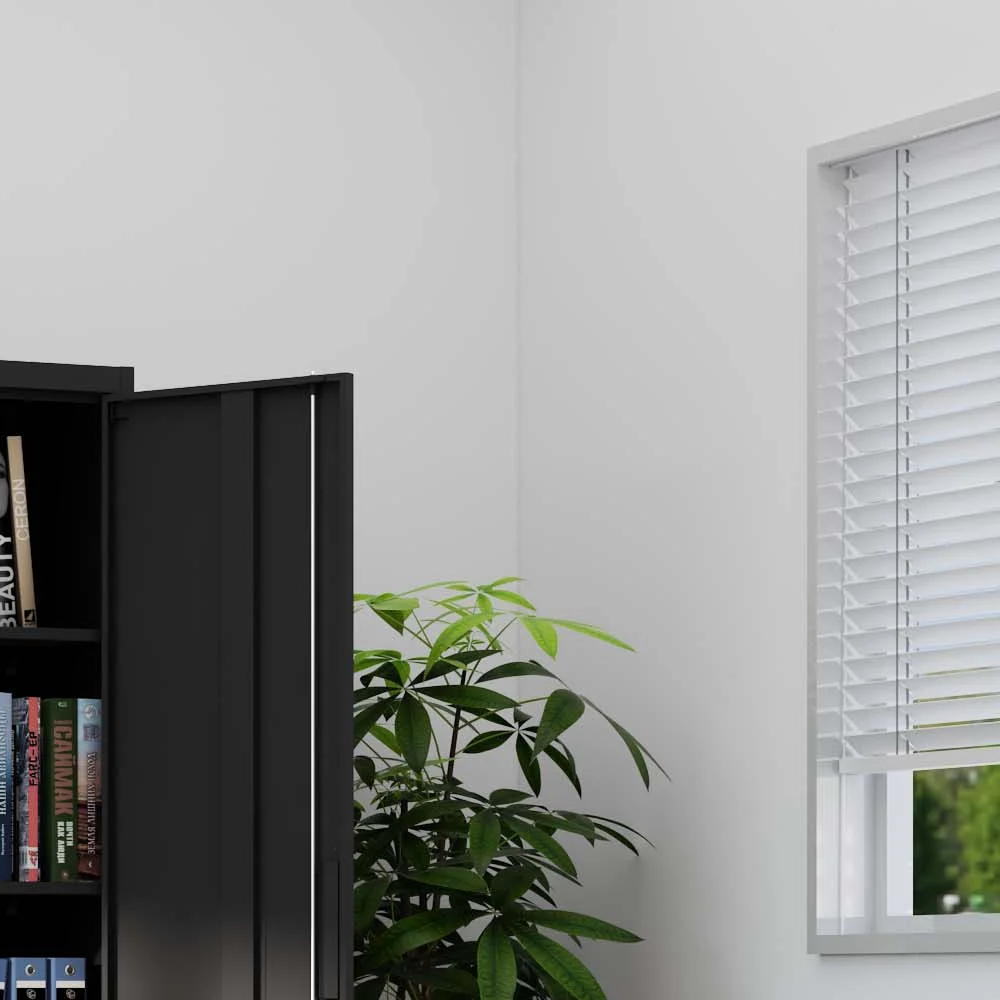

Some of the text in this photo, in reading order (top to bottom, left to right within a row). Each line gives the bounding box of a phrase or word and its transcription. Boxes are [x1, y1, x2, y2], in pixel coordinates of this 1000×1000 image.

[12, 479, 29, 541] CERON
[56, 821, 65, 864] КАК ЛЮДИ
[66, 821, 74, 847] ПОЧТИ
[87, 827, 96, 855] ЗЕМЛЯ
